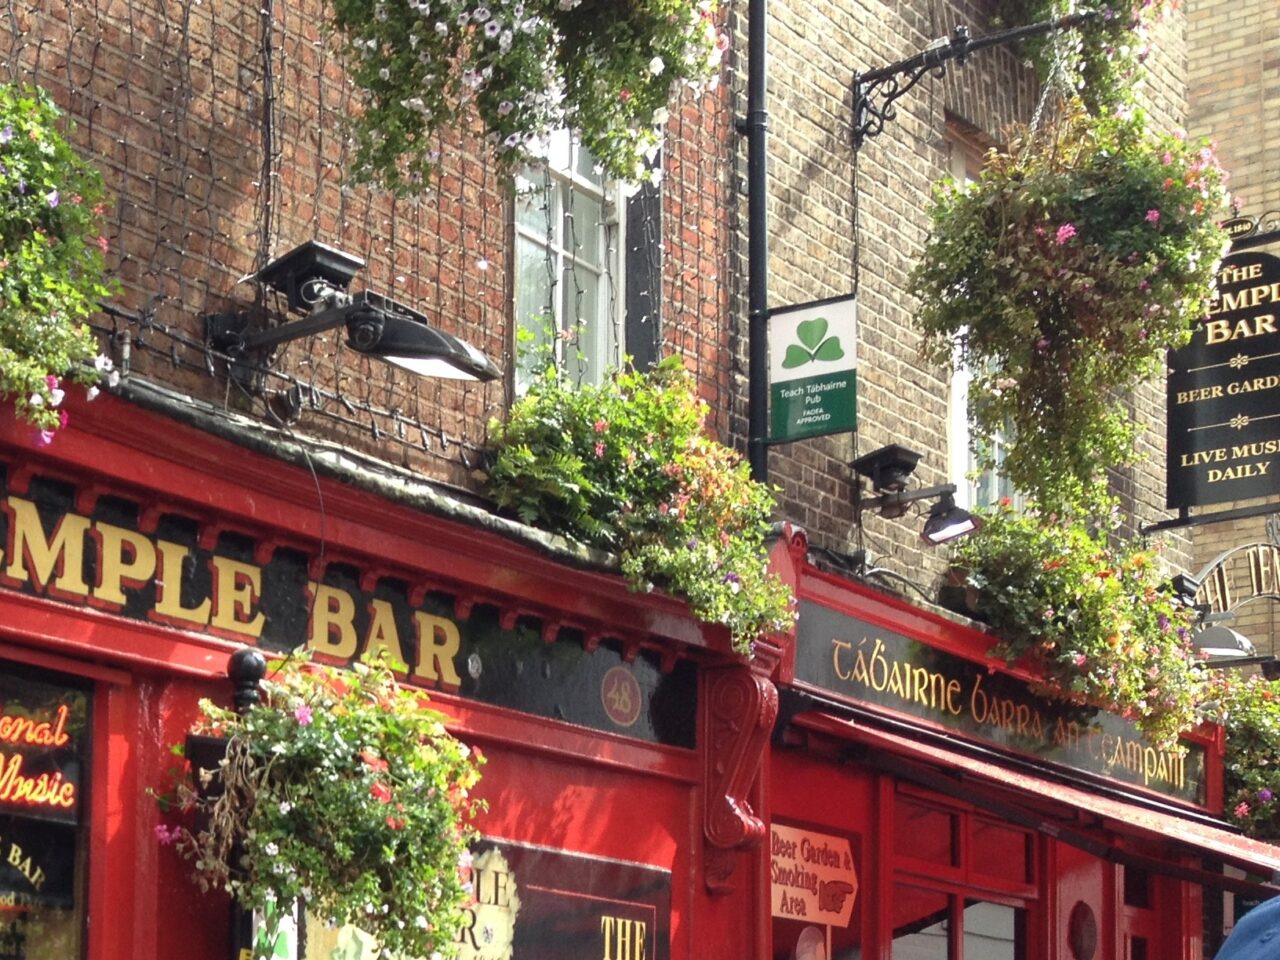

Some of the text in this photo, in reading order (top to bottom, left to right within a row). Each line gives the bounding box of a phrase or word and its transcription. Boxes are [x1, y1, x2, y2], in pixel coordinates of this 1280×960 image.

[1219, 263, 1263, 285] THE
[1206, 314, 1278, 346] BAR
[780, 387, 804, 398] Teach
[805, 395, 821, 405] Pub
[1177, 375, 1280, 405] BEER GARD
[796, 413, 831, 425] APPROVED
[1181, 448, 1227, 467] LIVE
[1208, 461, 1271, 483] DAILY
[306, 581, 462, 690] BAR
[607, 676, 631, 713] 48
[771, 830, 797, 859] Beer
[801, 837, 841, 868] Garden
[7, 843, 47, 890] BAR
[771, 859, 817, 896] Smoking
[780, 889, 807, 916] Area
